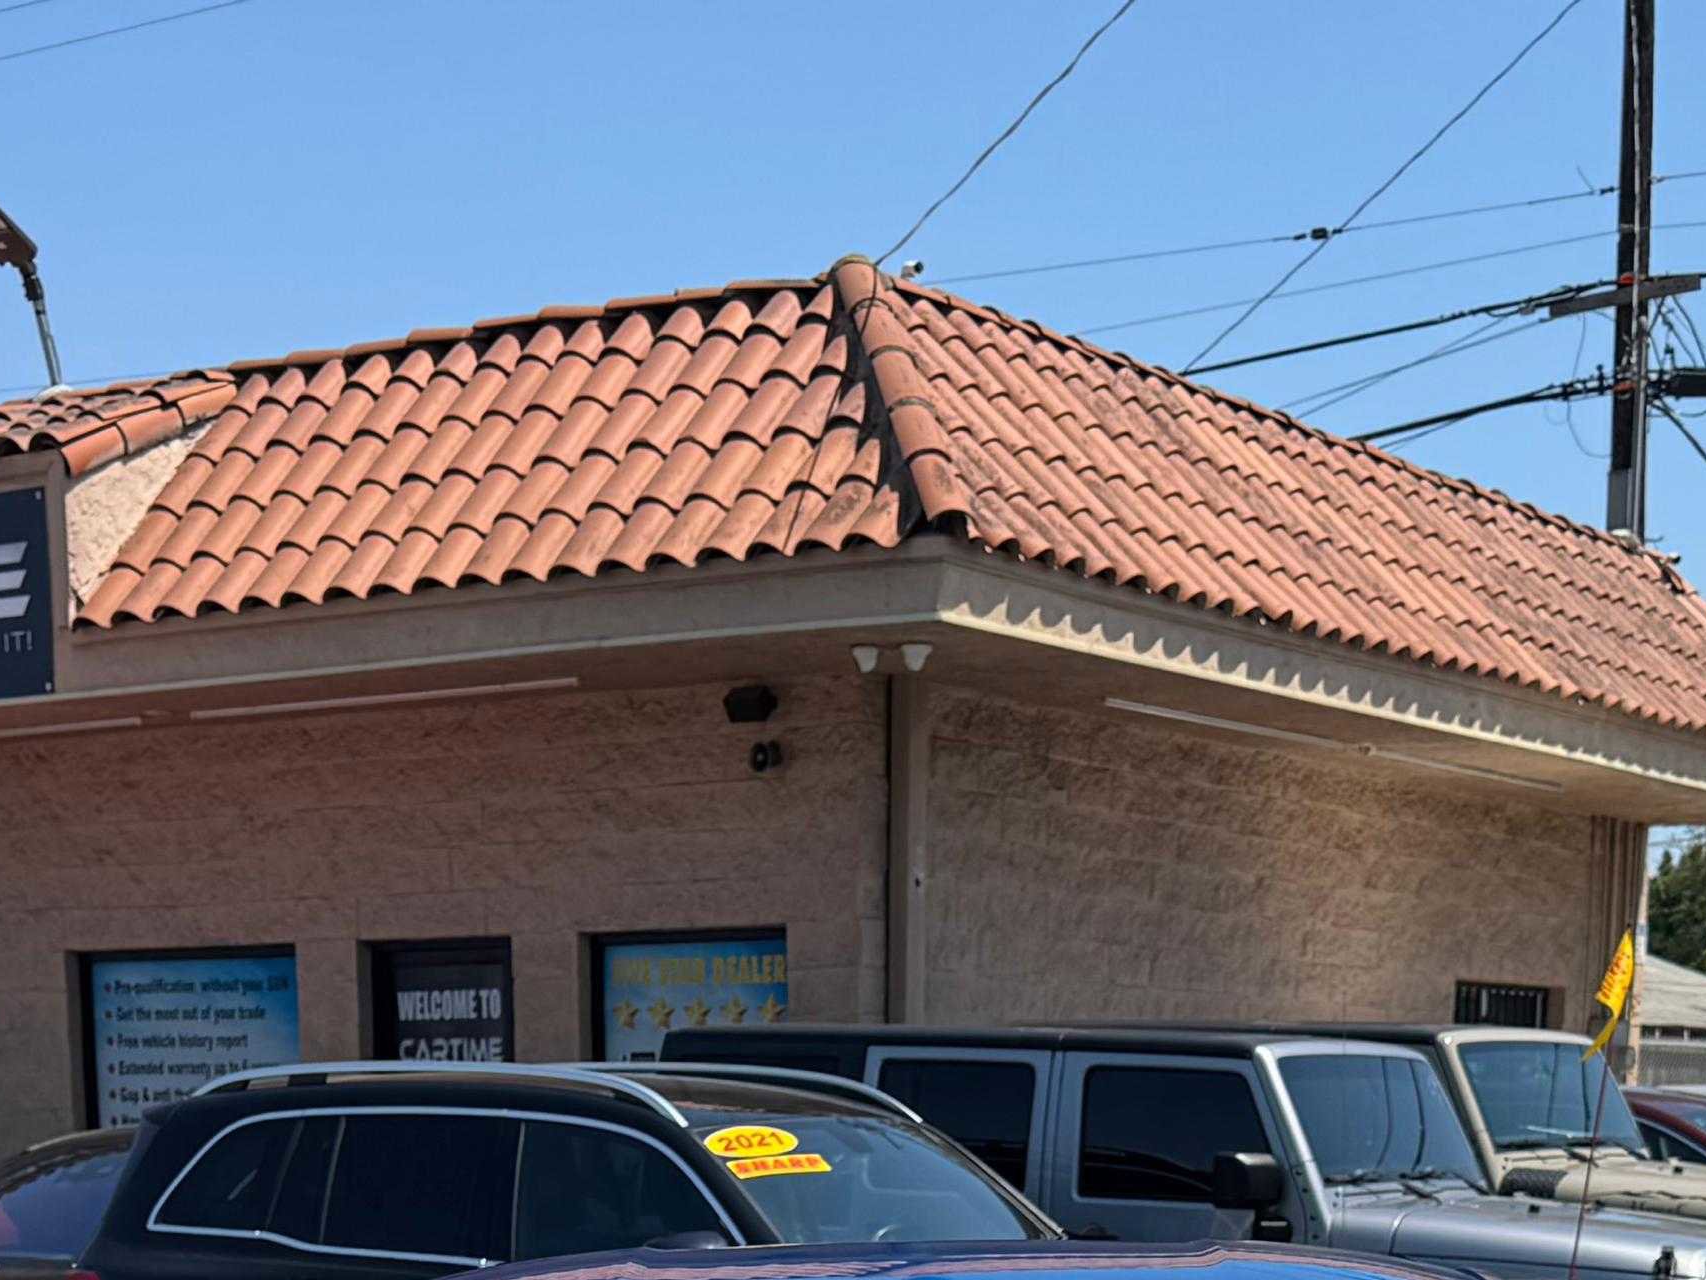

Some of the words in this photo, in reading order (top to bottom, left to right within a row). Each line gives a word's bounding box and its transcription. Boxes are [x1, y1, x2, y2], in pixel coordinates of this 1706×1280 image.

[4, 630, 33, 653] IT!
[712, 954, 787, 983] DEALER
[136, 1006, 152, 1020] the
[155, 1007, 179, 1021] most
[201, 1006, 213, 1020] of
[214, 1008, 236, 1024] your
[238, 1005, 266, 1020] trade
[397, 990, 477, 1021] WELCOME
[479, 989, 501, 1019] TO
[117, 1033, 138, 1048] Free
[142, 1033, 175, 1048] vehicle
[178, 1032, 213, 1052] history
[217, 1033, 248, 1052] report
[399, 1037, 503, 1061] CARTIME
[118, 1059, 164, 1076] Extended
[167, 1060, 212, 1080] warranty
[717, 1131, 785, 1152] 2021
[734, 1155, 823, 1174] SHARP
